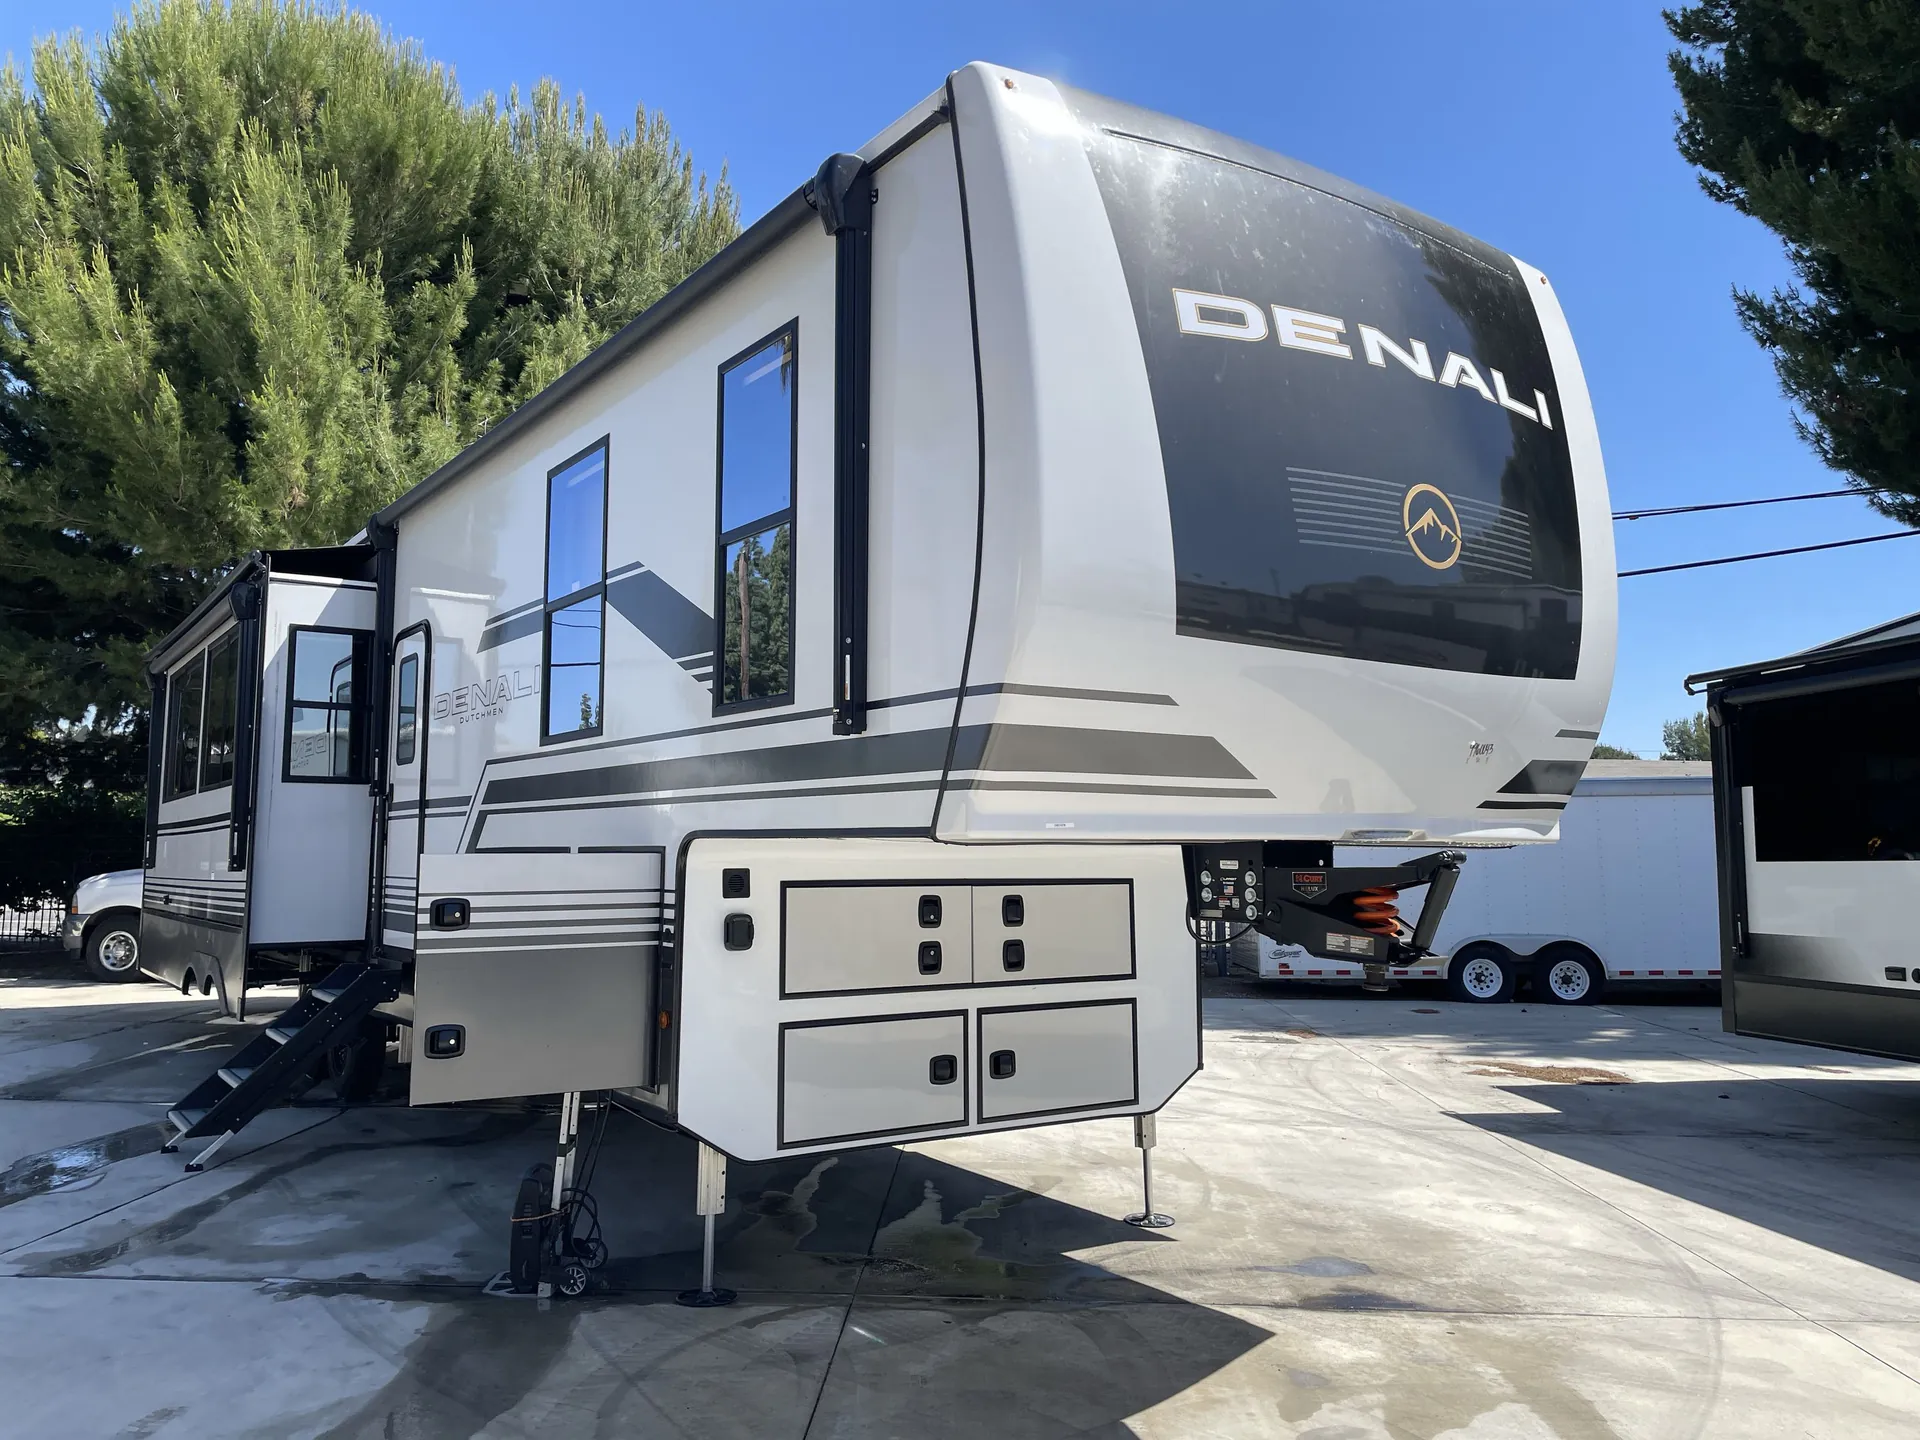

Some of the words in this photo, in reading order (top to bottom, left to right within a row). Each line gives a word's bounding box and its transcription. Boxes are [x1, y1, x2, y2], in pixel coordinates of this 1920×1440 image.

[1172, 287, 1553, 430] DENALI
[434, 664, 541, 720] DENALI
[459, 707, 504, 724] DUTCHMEN
